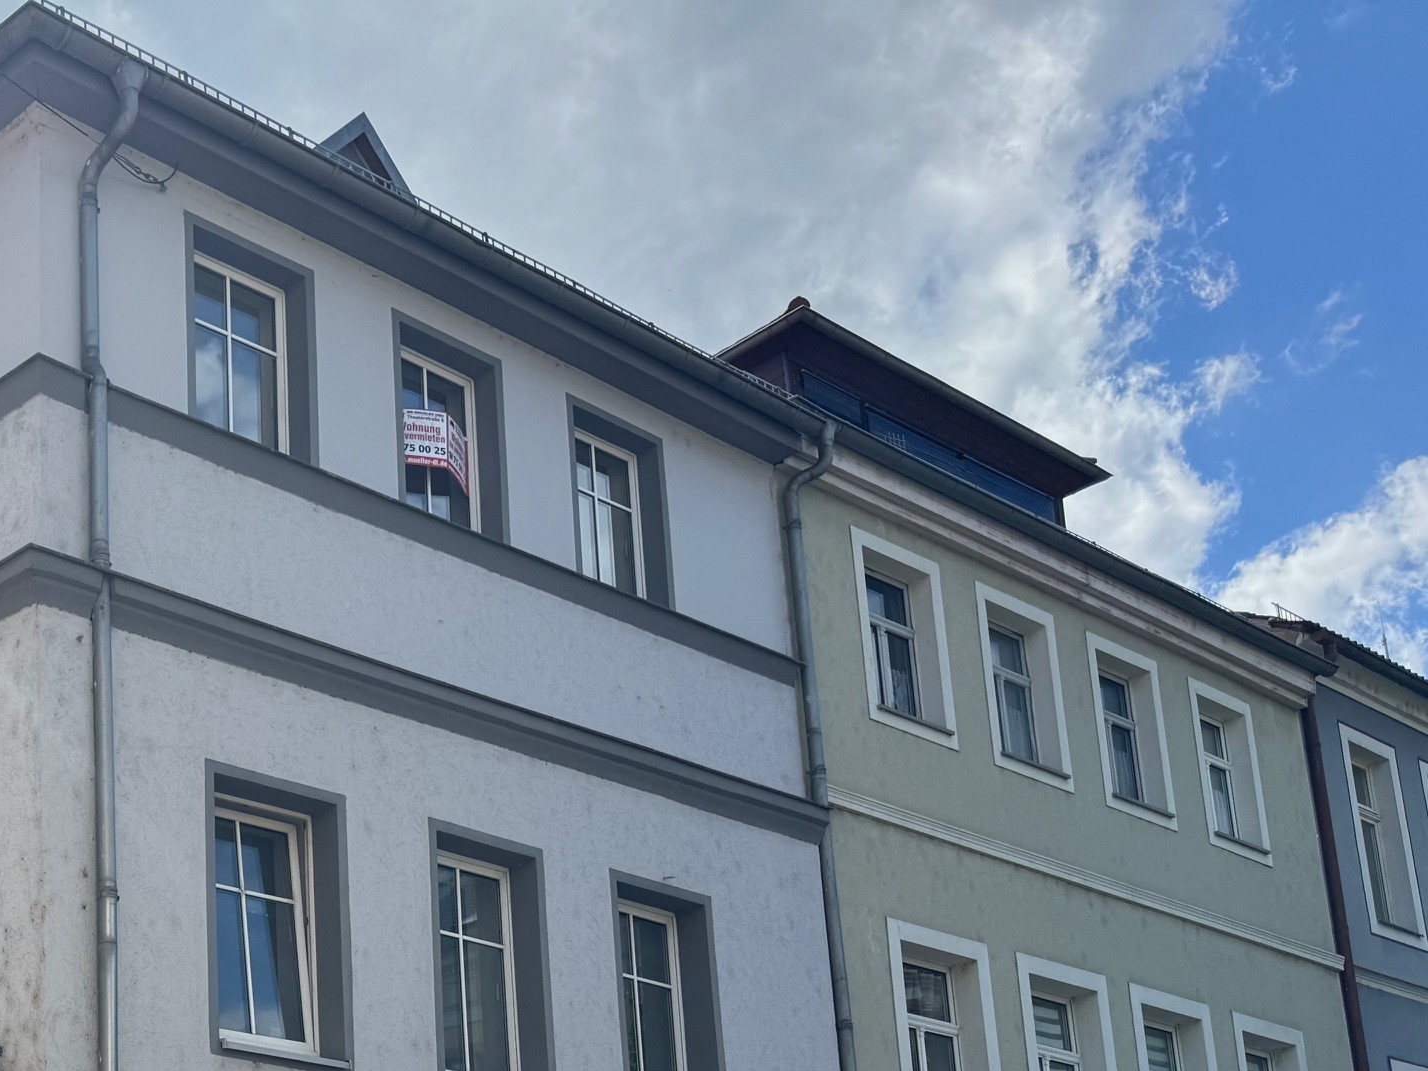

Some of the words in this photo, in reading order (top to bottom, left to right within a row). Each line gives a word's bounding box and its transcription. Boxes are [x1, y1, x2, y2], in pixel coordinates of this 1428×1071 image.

[404, 444, 415, 452] 75
[419, 445, 431, 453] 00
[434, 447, 446, 455] 25
